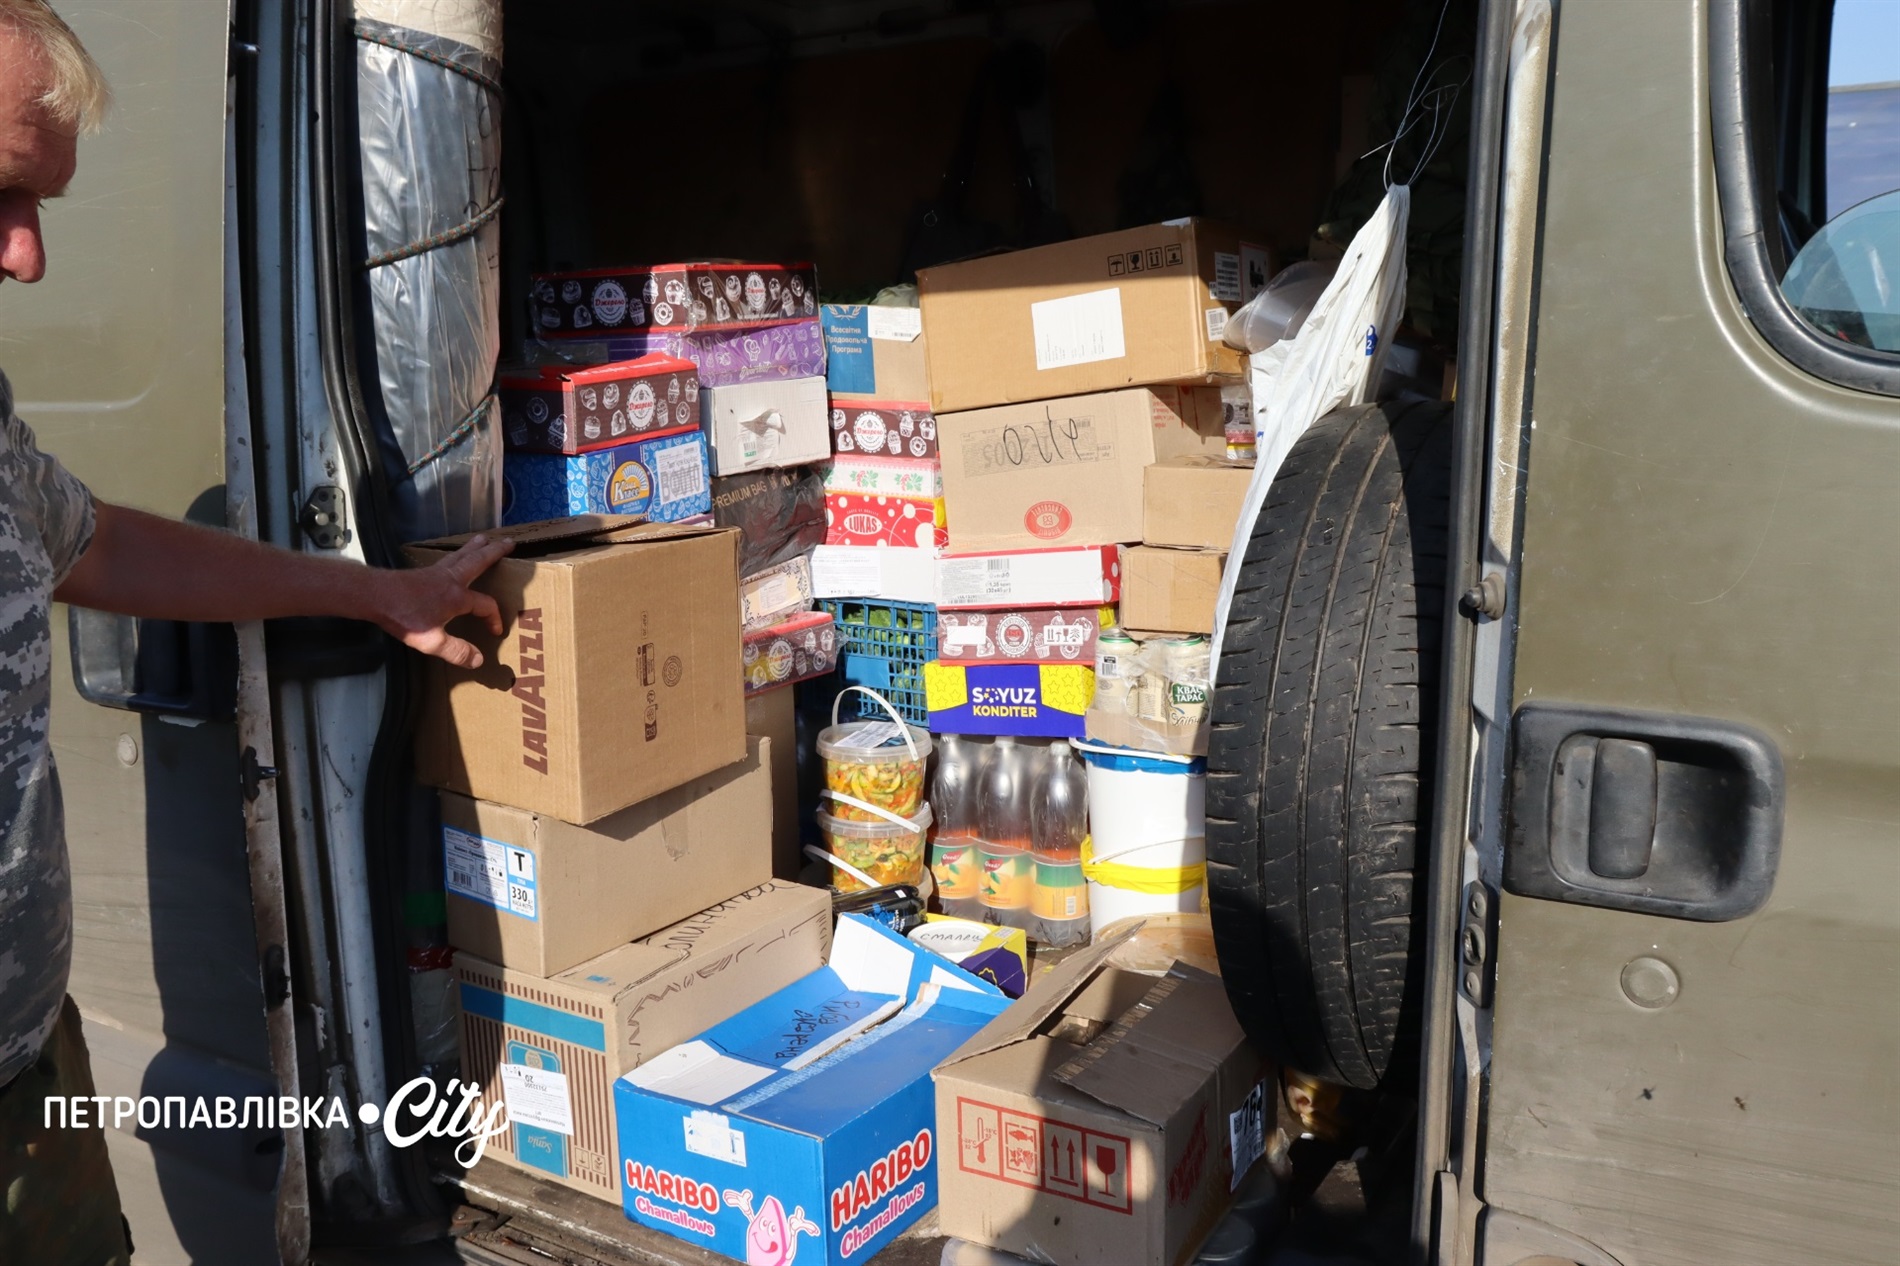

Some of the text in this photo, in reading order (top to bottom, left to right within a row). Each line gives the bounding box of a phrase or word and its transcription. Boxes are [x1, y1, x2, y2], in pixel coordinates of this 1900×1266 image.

[830, 325, 862, 334] Всесвітня
[826, 335, 868, 344] Продовольча
[832, 345, 863, 354] Програма
[712, 486, 752, 511] PREMIUM
[751, 480, 768, 496] BAG
[848, 515, 878, 533] LUKAS
[511, 607, 548, 776] LAVAZZA
[972, 686, 1037, 705] SOYUZ
[1175, 693, 1204, 703] ТАРАС
[1176, 685, 1203, 695] КВАС
[972, 705, 1037, 718] KONDITER
[512, 887, 527, 901] 330
[527, 1135, 553, 1153] Sania
[626, 1160, 719, 1213] HARIBO
[830, 1128, 931, 1231] HARIBO
[636, 1196, 715, 1236] Chamallows
[841, 1182, 925, 1257] Chamallows
